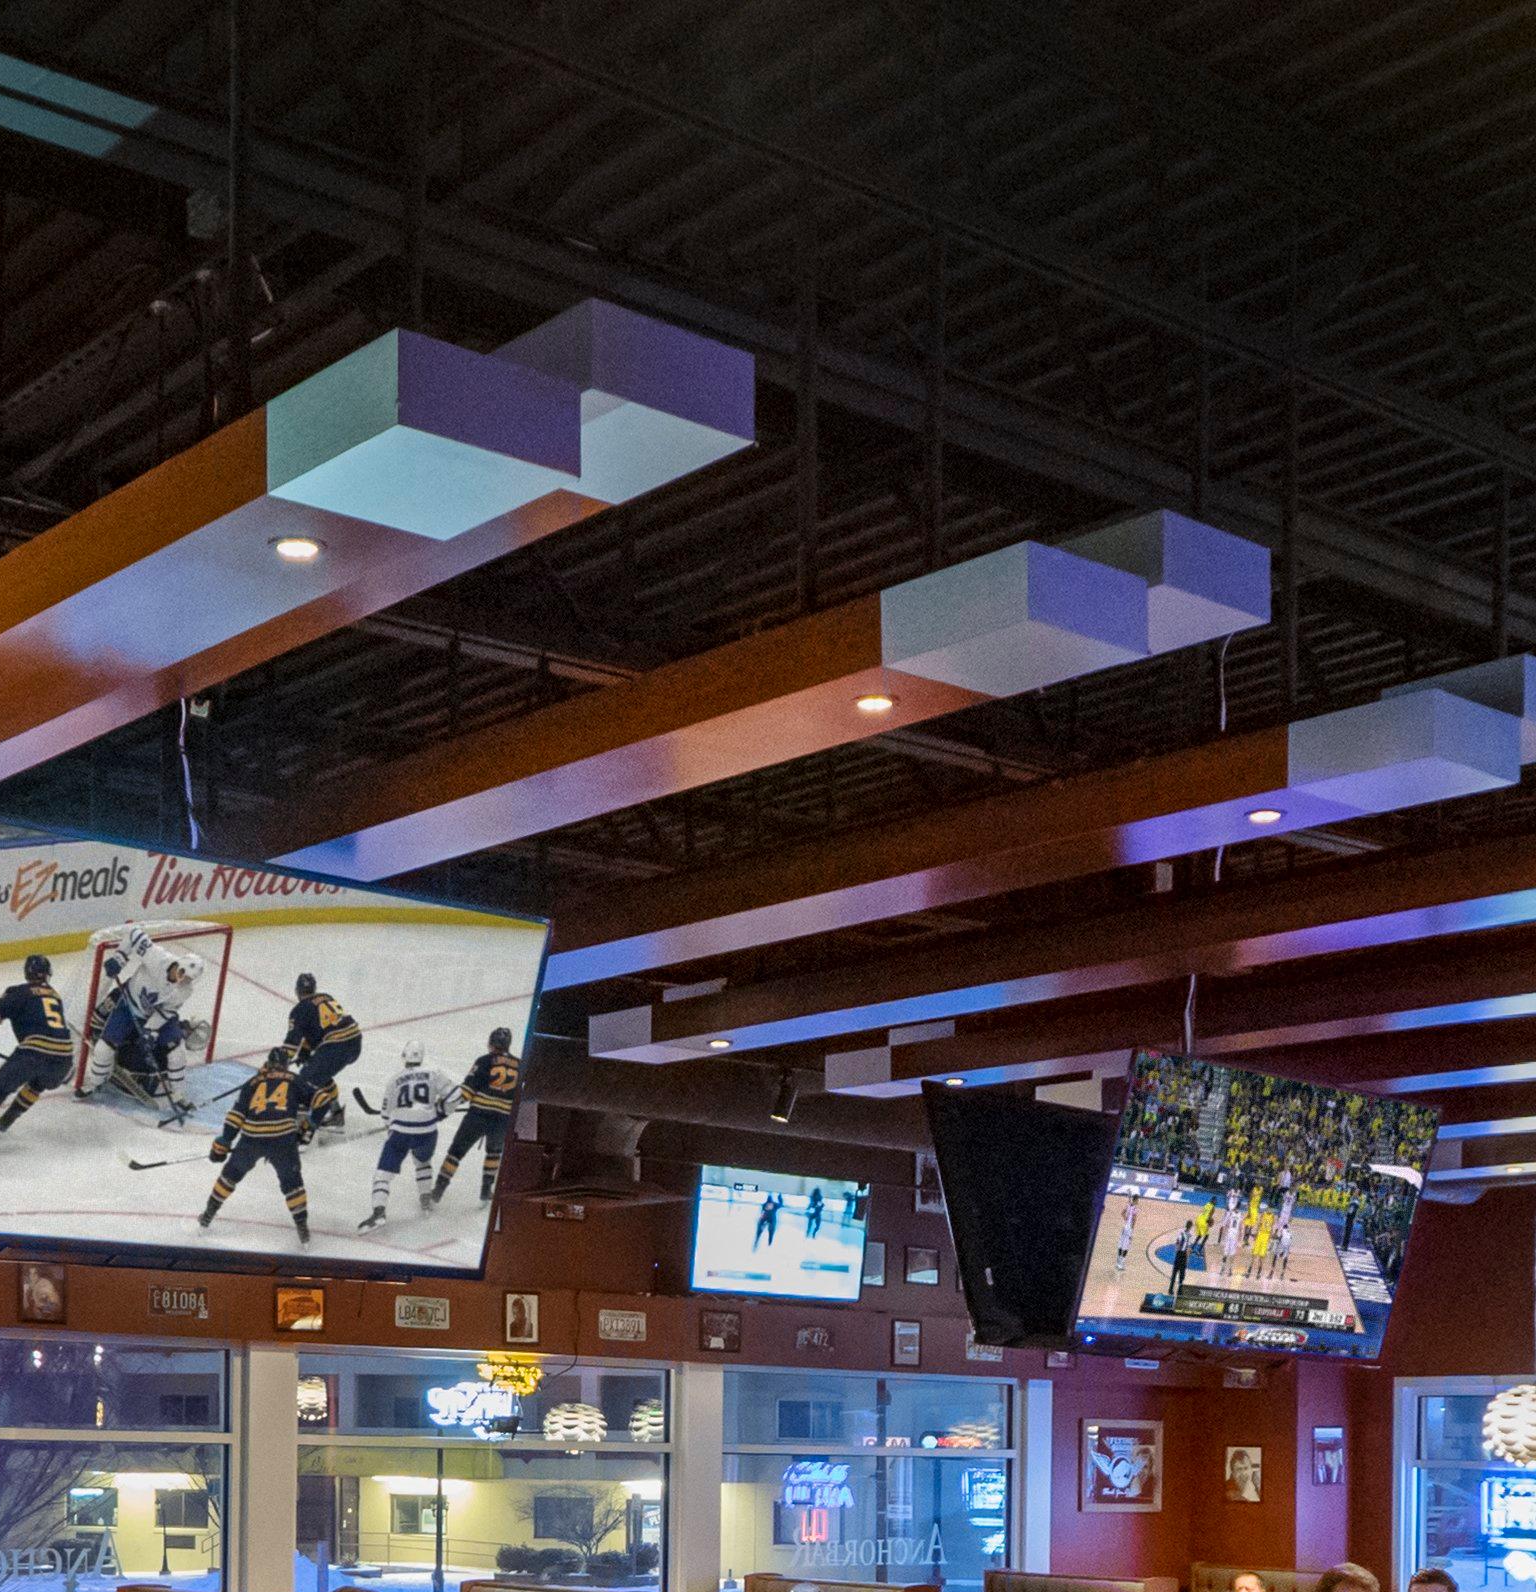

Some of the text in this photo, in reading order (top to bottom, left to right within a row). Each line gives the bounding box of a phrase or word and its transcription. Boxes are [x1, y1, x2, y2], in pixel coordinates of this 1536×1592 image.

[142, 851, 203, 909] Tim
[42, 997, 65, 1028] 5
[249, 1081, 289, 1114] 44
